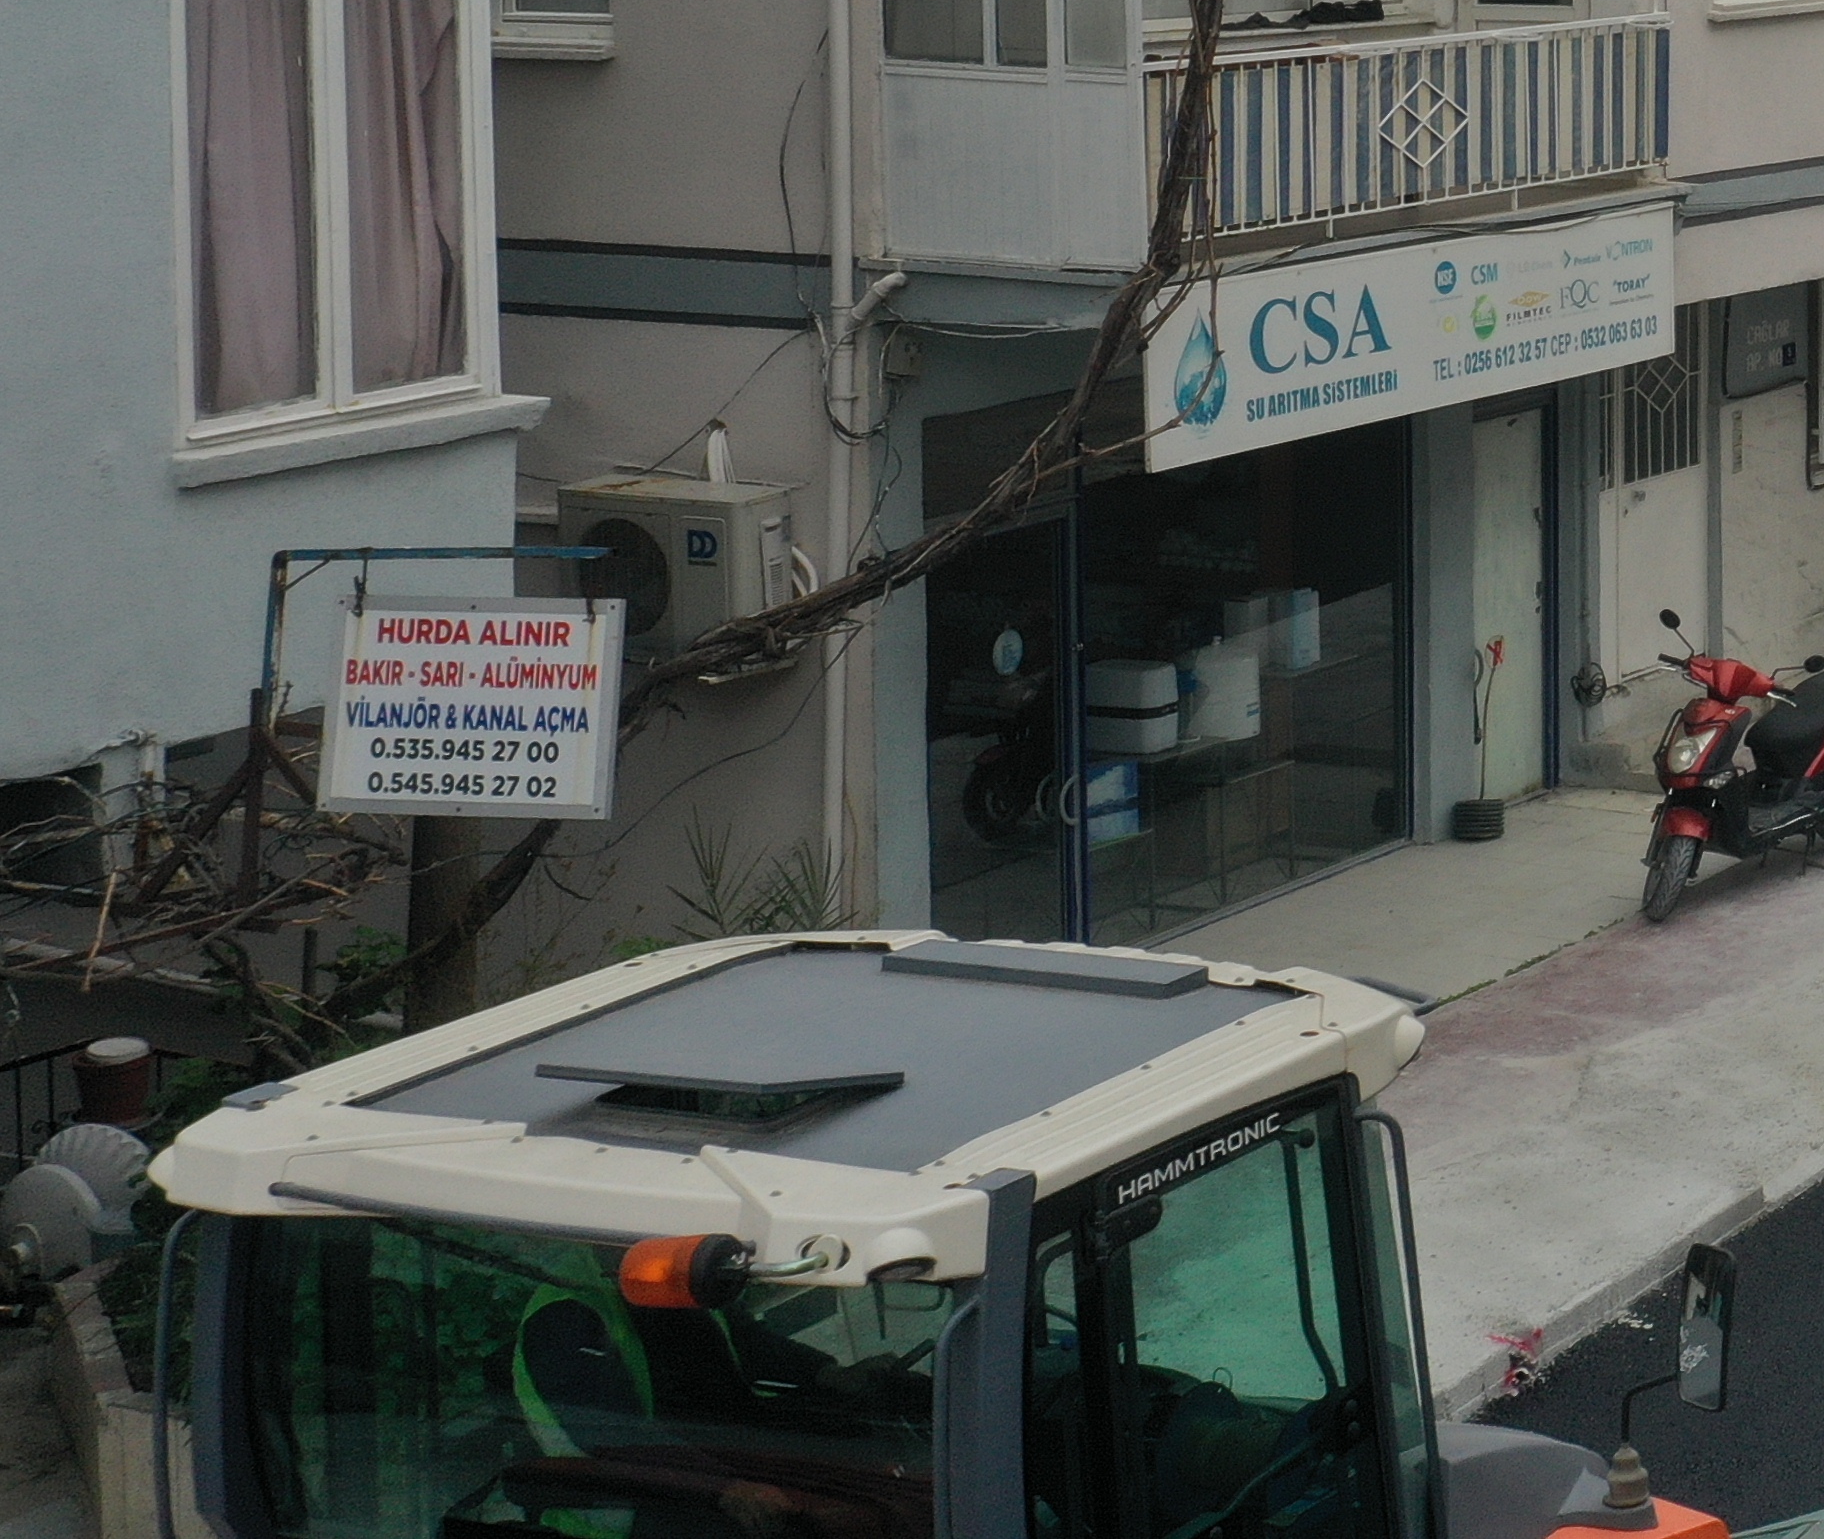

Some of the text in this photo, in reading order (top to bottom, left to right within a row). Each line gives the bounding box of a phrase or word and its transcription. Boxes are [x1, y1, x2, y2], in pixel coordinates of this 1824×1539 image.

[1471, 263, 1498, 285] CSM
[1248, 284, 1393, 375] CSA
[1506, 305, 1552, 323] FILMTEC
[1433, 359, 1454, 381] TEL
[1464, 349, 1492, 375] 0256
[1495, 344, 1515, 368] 612
[1518, 341, 1532, 364] 32
[1534, 337, 1548, 361] 57
[1550, 336, 1571, 357] CEP
[1581, 325, 1607, 350] 0532
[1609, 320, 1628, 344] 063
[1630, 318, 1643, 340] 63
[1645, 315, 1658, 336] 03
[1246, 398, 1265, 422] SU
[1267, 387, 1320, 417] ARITMA
[376, 617, 572, 648] HURDA ALINIR
[345, 659, 403, 686] BAKIR
[420, 661, 464, 688] SARI
[480, 657, 598, 691] ALÜMİNYUM
[445, 704, 457, 729] &
[462, 704, 528, 733] KANAL
[533, 707, 590, 737] AÇMA
[370, 737, 560, 763] 0.535.945 27 00
[367, 771, 557, 798] 0.545.945 27 02
[1117, 1112, 1282, 1205] HAMMTRONIC
